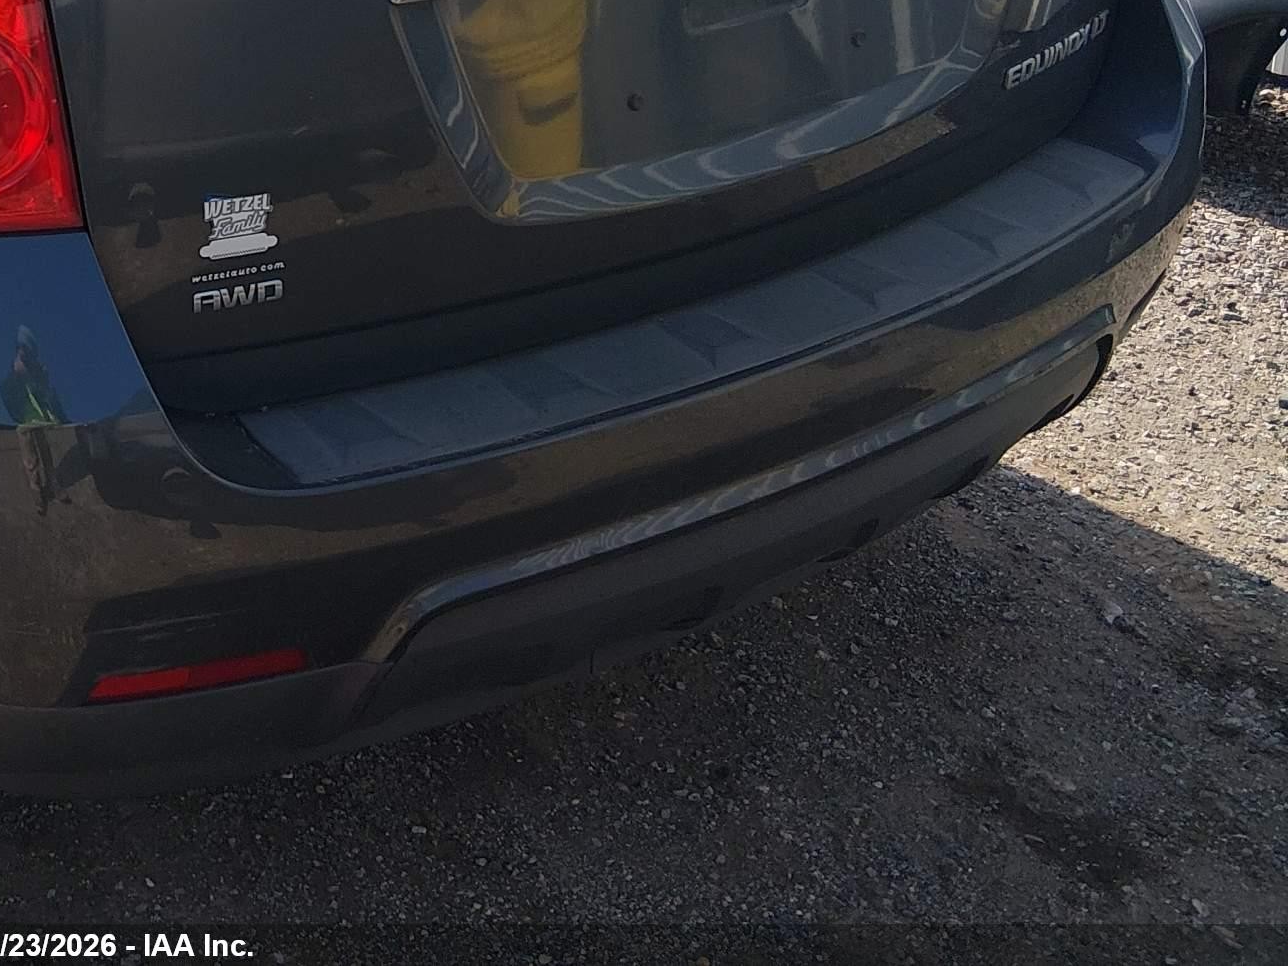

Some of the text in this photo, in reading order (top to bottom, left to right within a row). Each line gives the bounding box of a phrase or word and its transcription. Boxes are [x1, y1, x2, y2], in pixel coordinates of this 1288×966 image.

[1004, 22, 1091, 90] EQUINOX
[203, 193, 271, 221] WETZEL
[211, 211, 268, 239] Family
[191, 261, 285, 283] wetzelautocom
[193, 279, 283, 314] AWD
